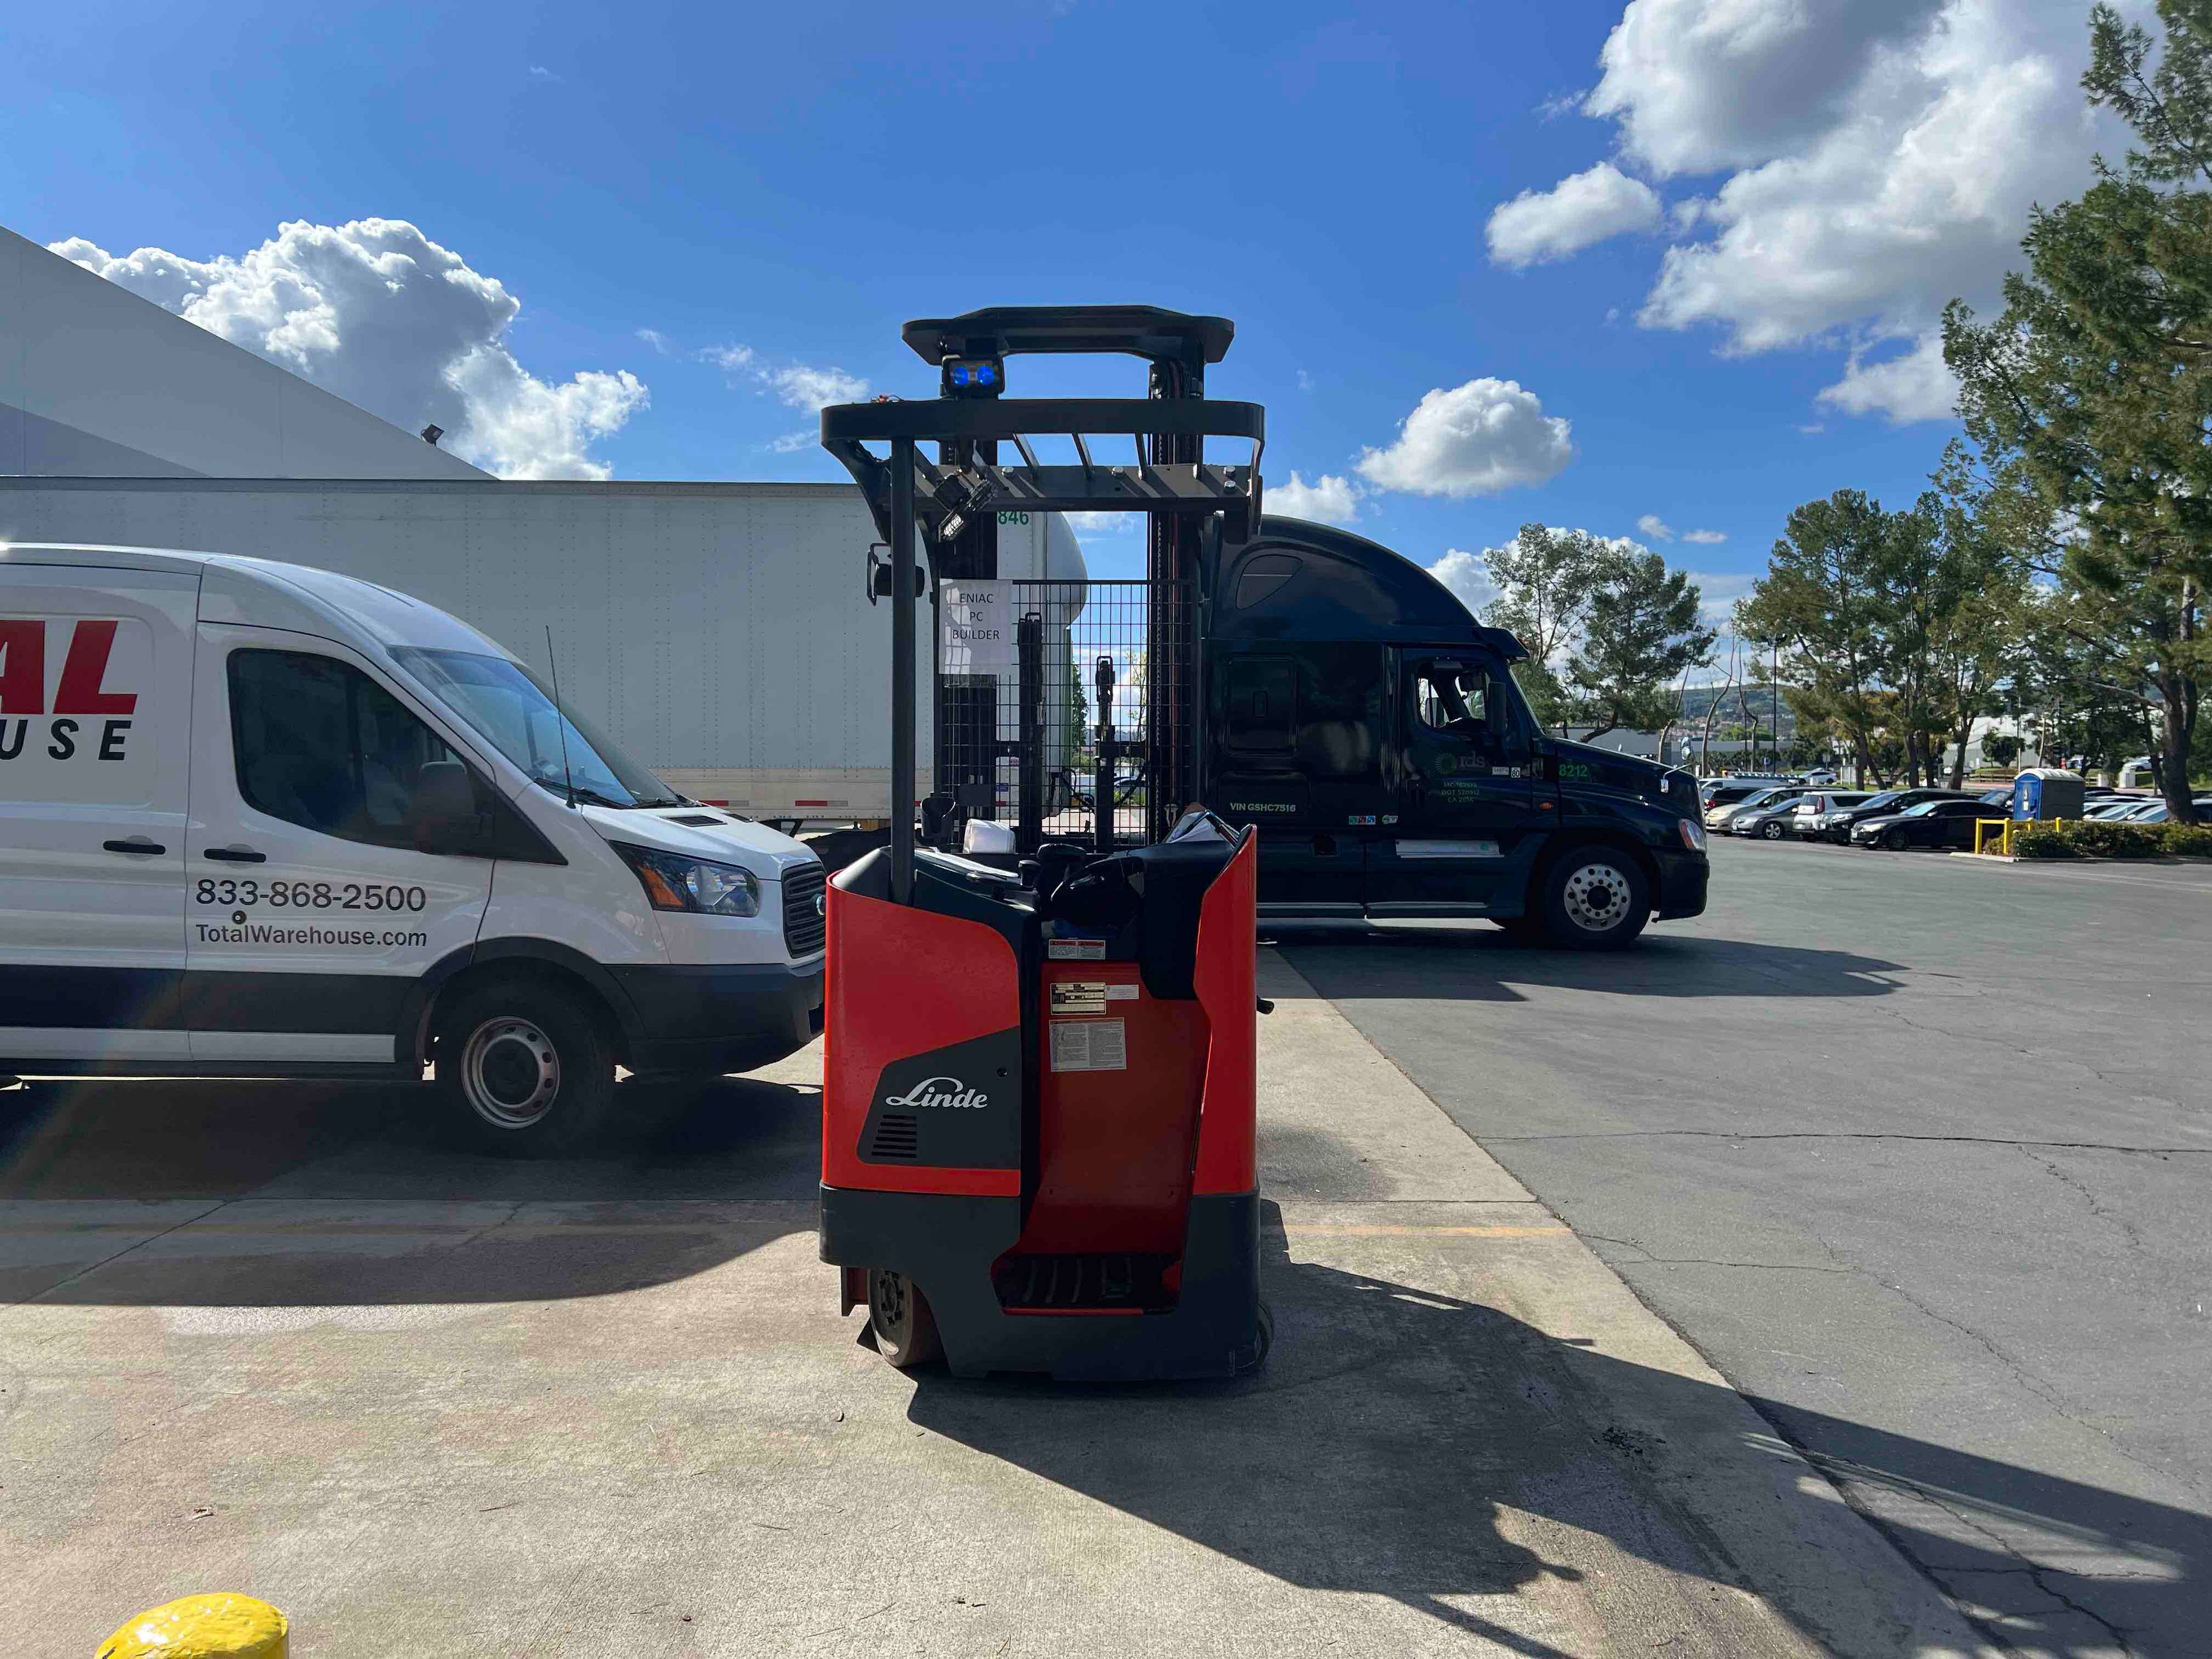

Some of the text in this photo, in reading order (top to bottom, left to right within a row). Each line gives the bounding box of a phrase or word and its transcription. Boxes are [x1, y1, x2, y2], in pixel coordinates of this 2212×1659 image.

[960, 593, 994, 604] ENIAC
[970, 612, 983, 622] PC
[952, 629, 1000, 640] BUILDER
[1558, 764, 1588, 778] 8212
[1230, 802, 1296, 812] VIN GSHC7516
[195, 878, 427, 912] 833-868-2500
[195, 923, 427, 947] TotalWarehouse.com
[885, 1077, 988, 1108] Linde
